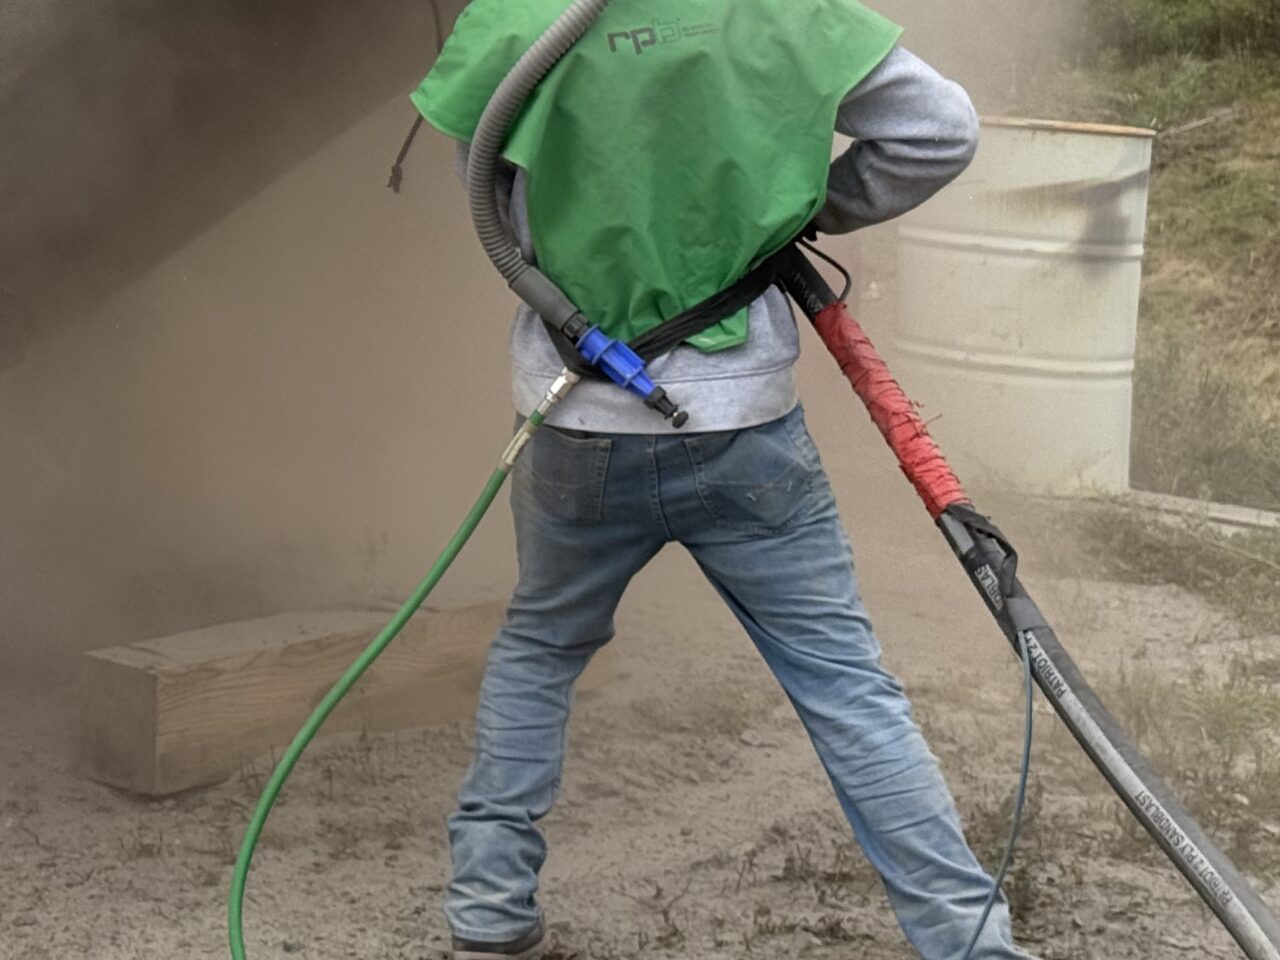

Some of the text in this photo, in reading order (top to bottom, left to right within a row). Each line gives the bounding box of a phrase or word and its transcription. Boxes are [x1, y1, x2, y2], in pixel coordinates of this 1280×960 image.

[1026, 642, 1039, 655] 2
[1031, 651, 1068, 699] PATRIOT
[1135, 790, 1185, 848] SANDBLAST
